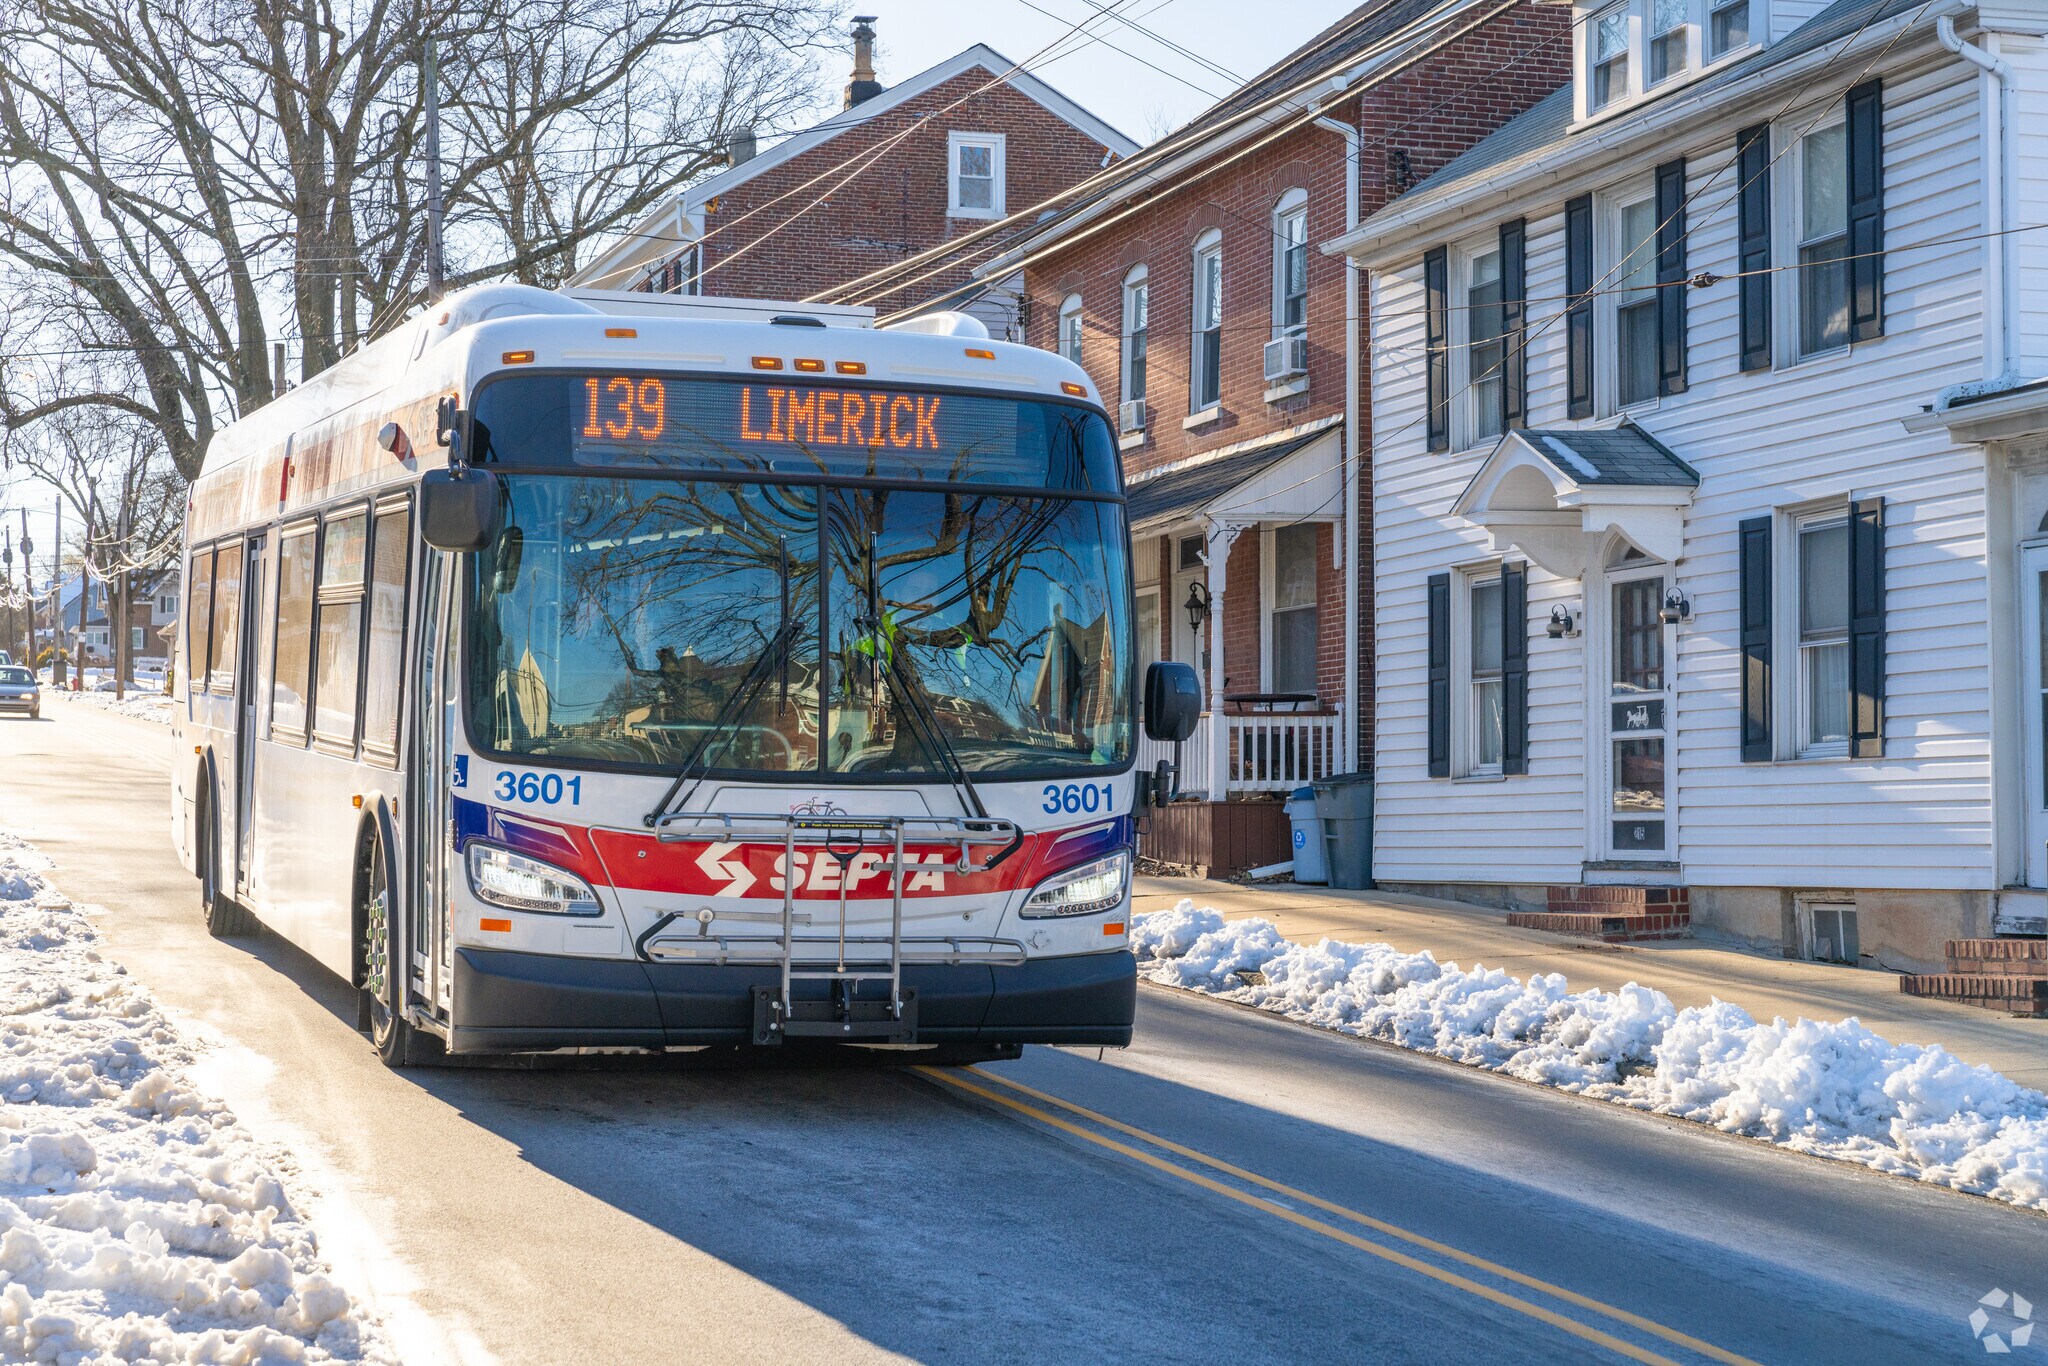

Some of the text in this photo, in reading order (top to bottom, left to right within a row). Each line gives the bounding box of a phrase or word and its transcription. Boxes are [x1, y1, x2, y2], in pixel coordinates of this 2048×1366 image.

[583, 377, 940, 449] 139 LIMERICK
[494, 771, 581, 805] 3601
[1042, 783, 1114, 813] 3601
[769, 851, 945, 892] SEPTA
